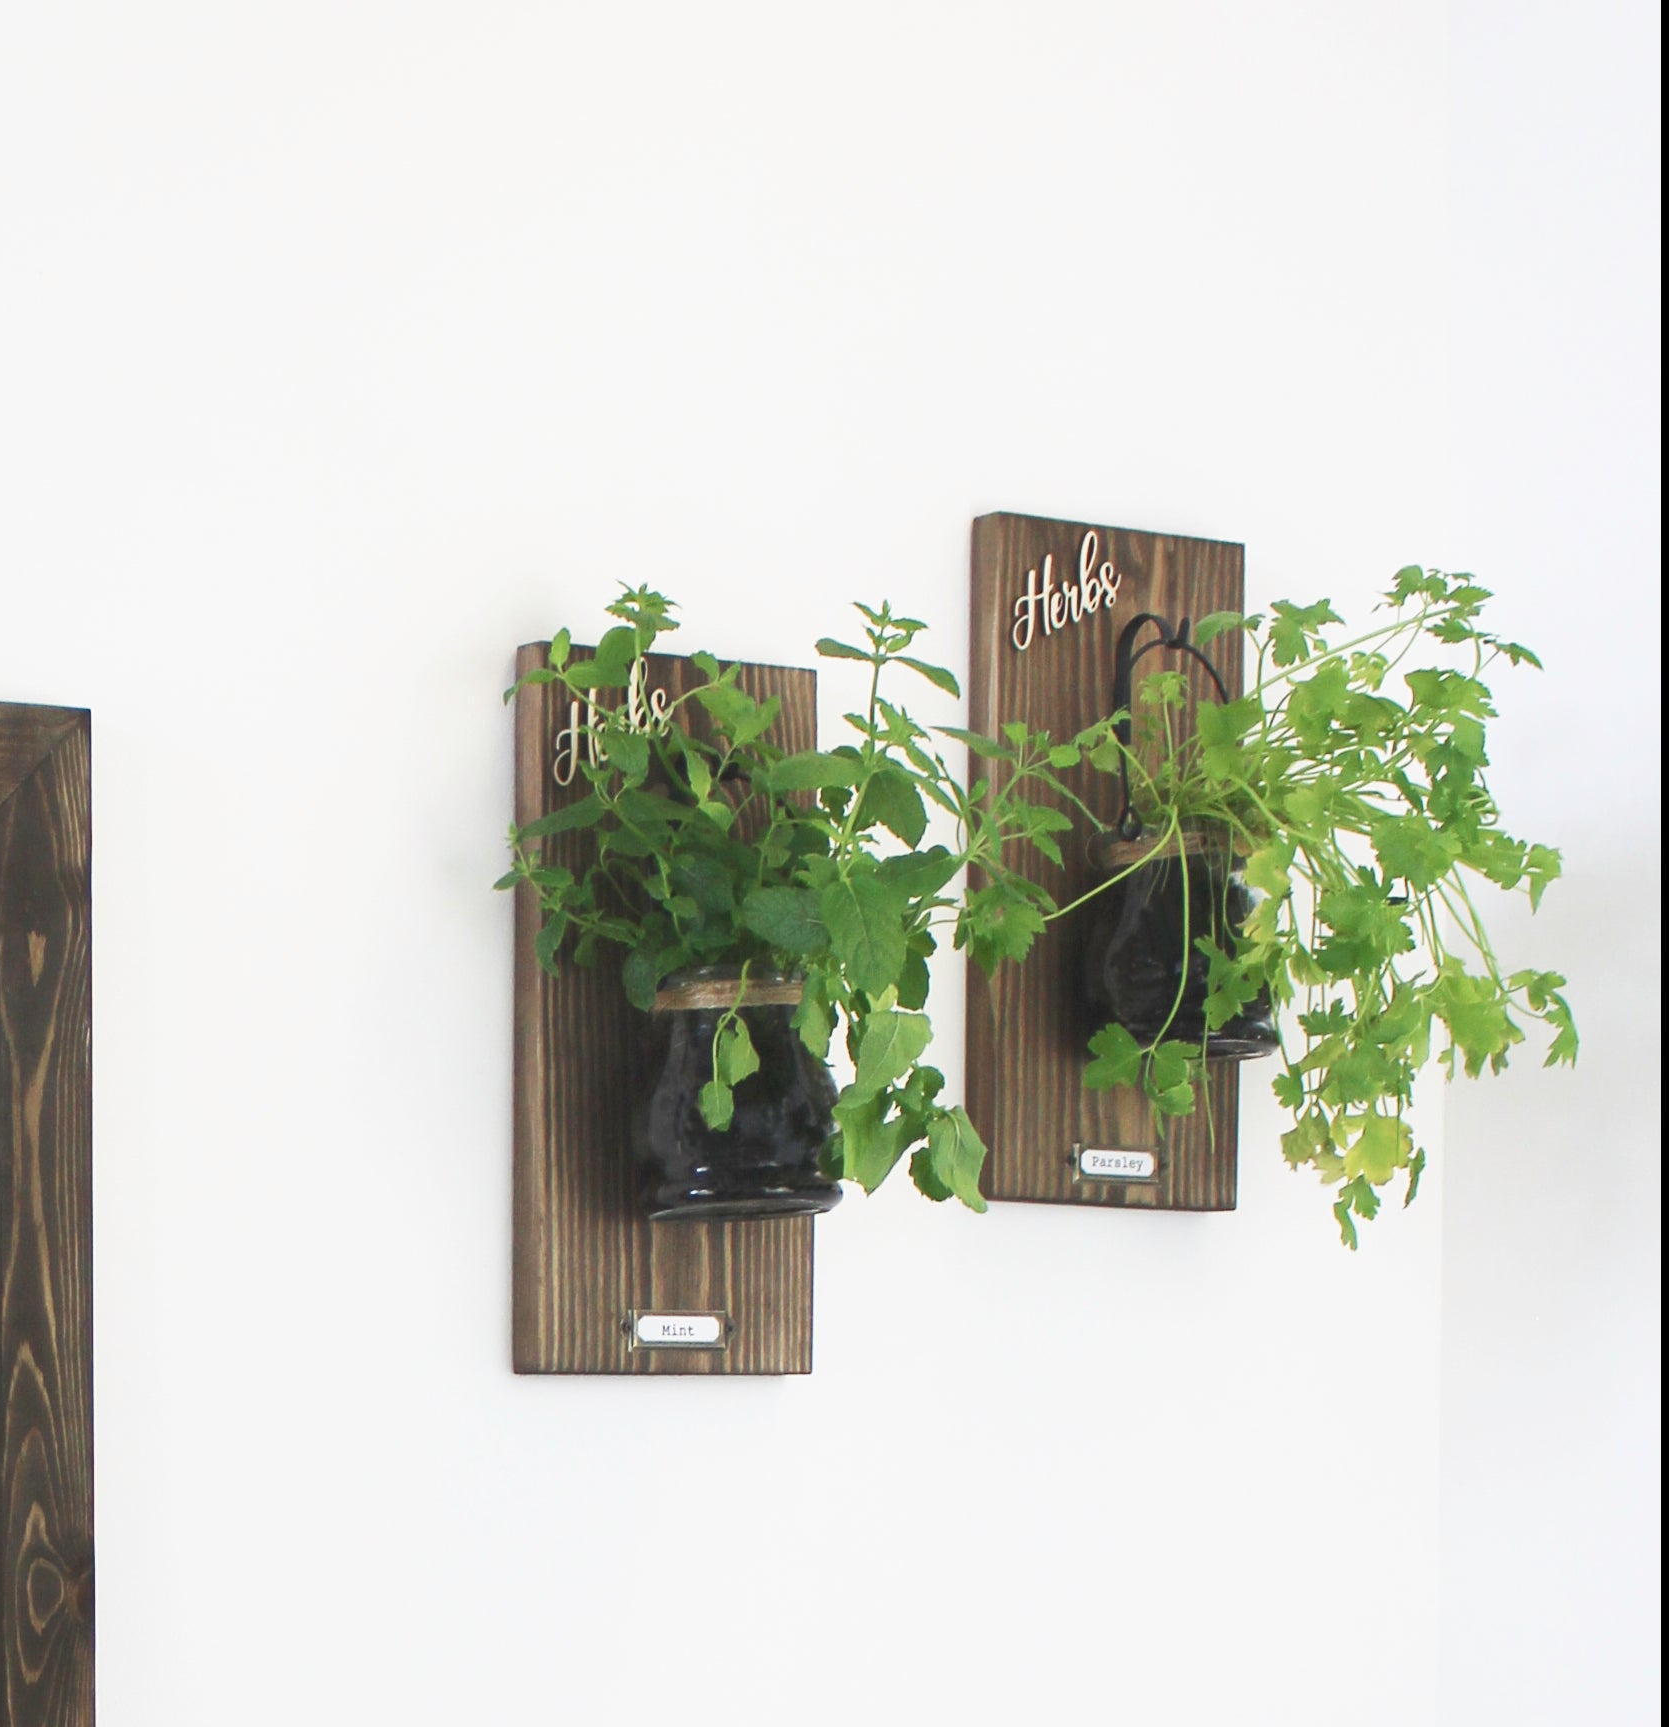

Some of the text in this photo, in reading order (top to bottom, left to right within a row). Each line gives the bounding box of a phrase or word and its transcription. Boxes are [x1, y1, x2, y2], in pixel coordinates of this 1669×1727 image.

[1012, 530, 1122, 651] Herbs
[1091, 1155, 1145, 1172] Parsley
[662, 1323, 695, 1336] Mint
